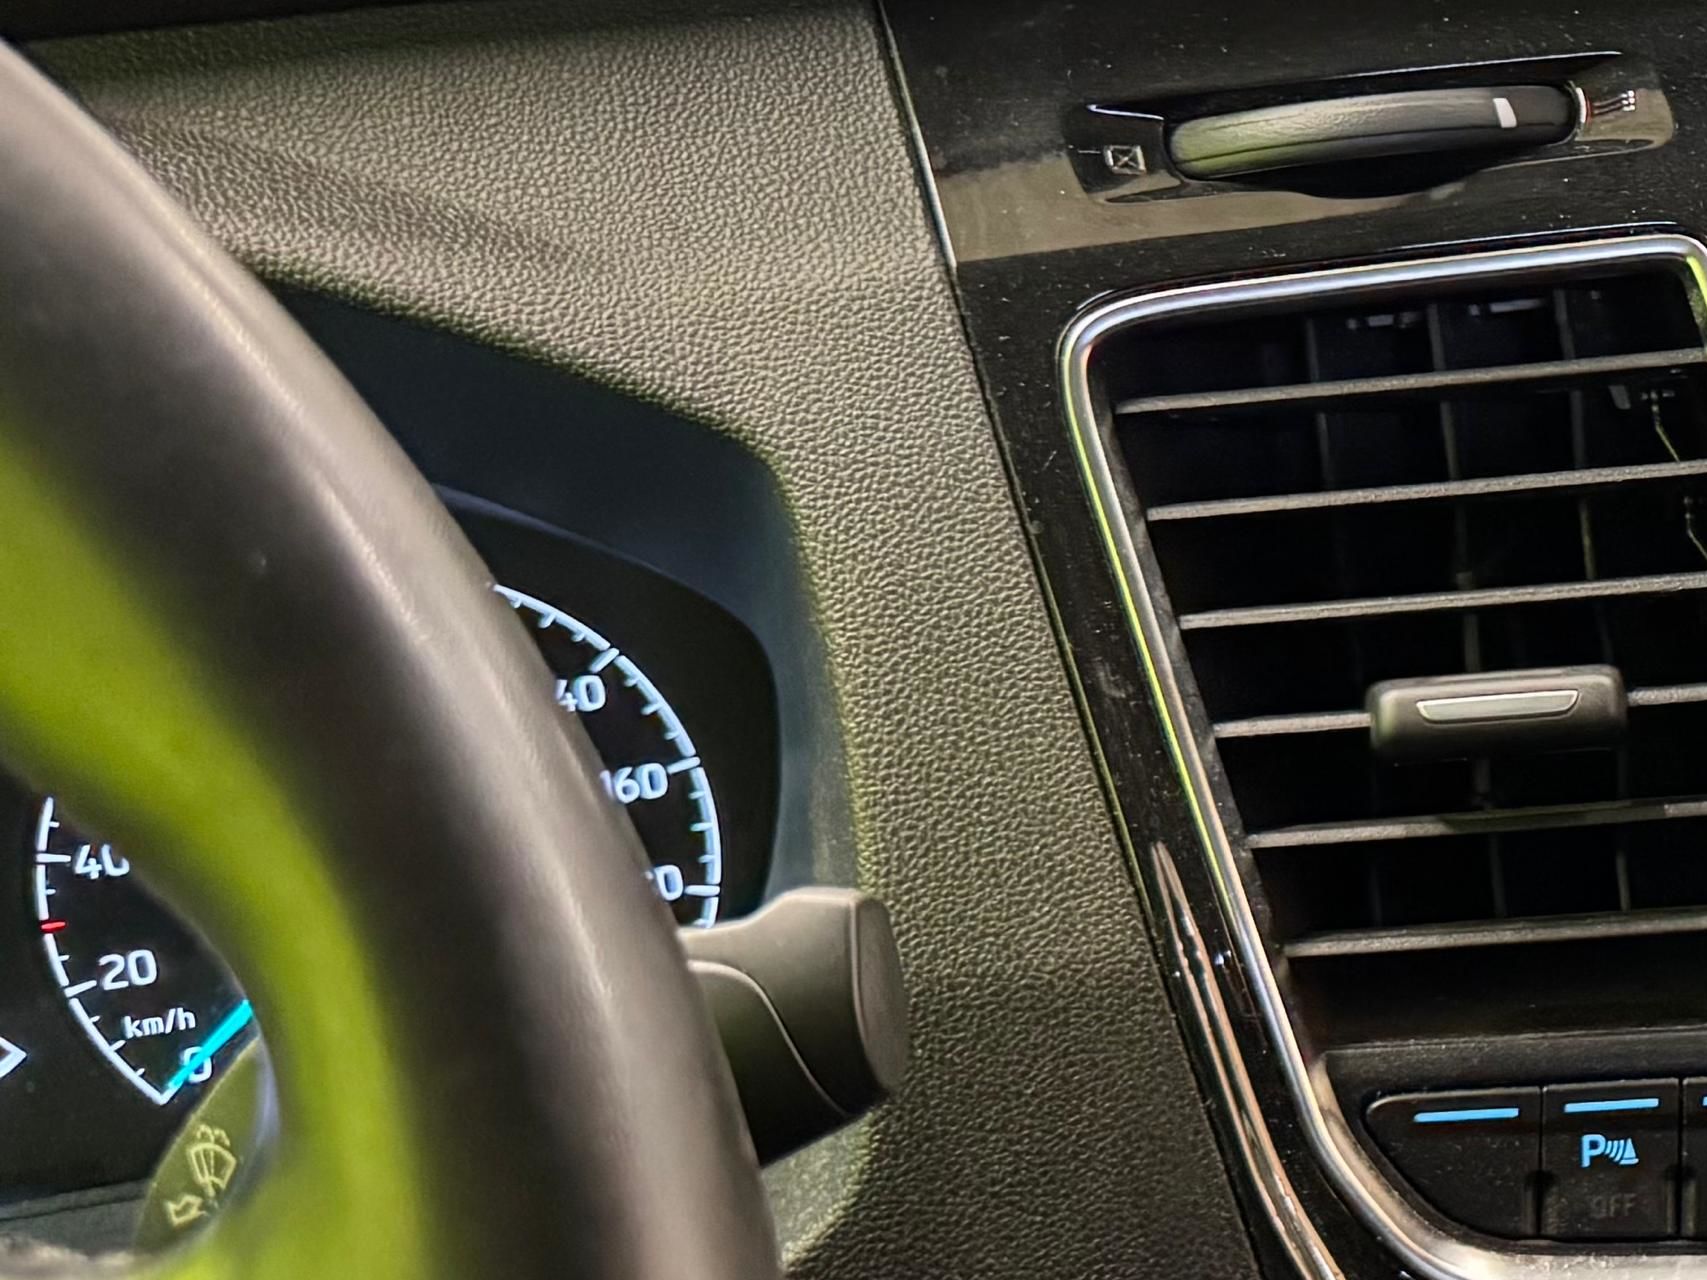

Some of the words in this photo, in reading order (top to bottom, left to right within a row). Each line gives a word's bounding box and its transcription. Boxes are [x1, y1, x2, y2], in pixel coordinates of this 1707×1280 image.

[74, 844, 130, 879] 40
[99, 949, 158, 990] 20
[122, 1007, 196, 1039] km/h
